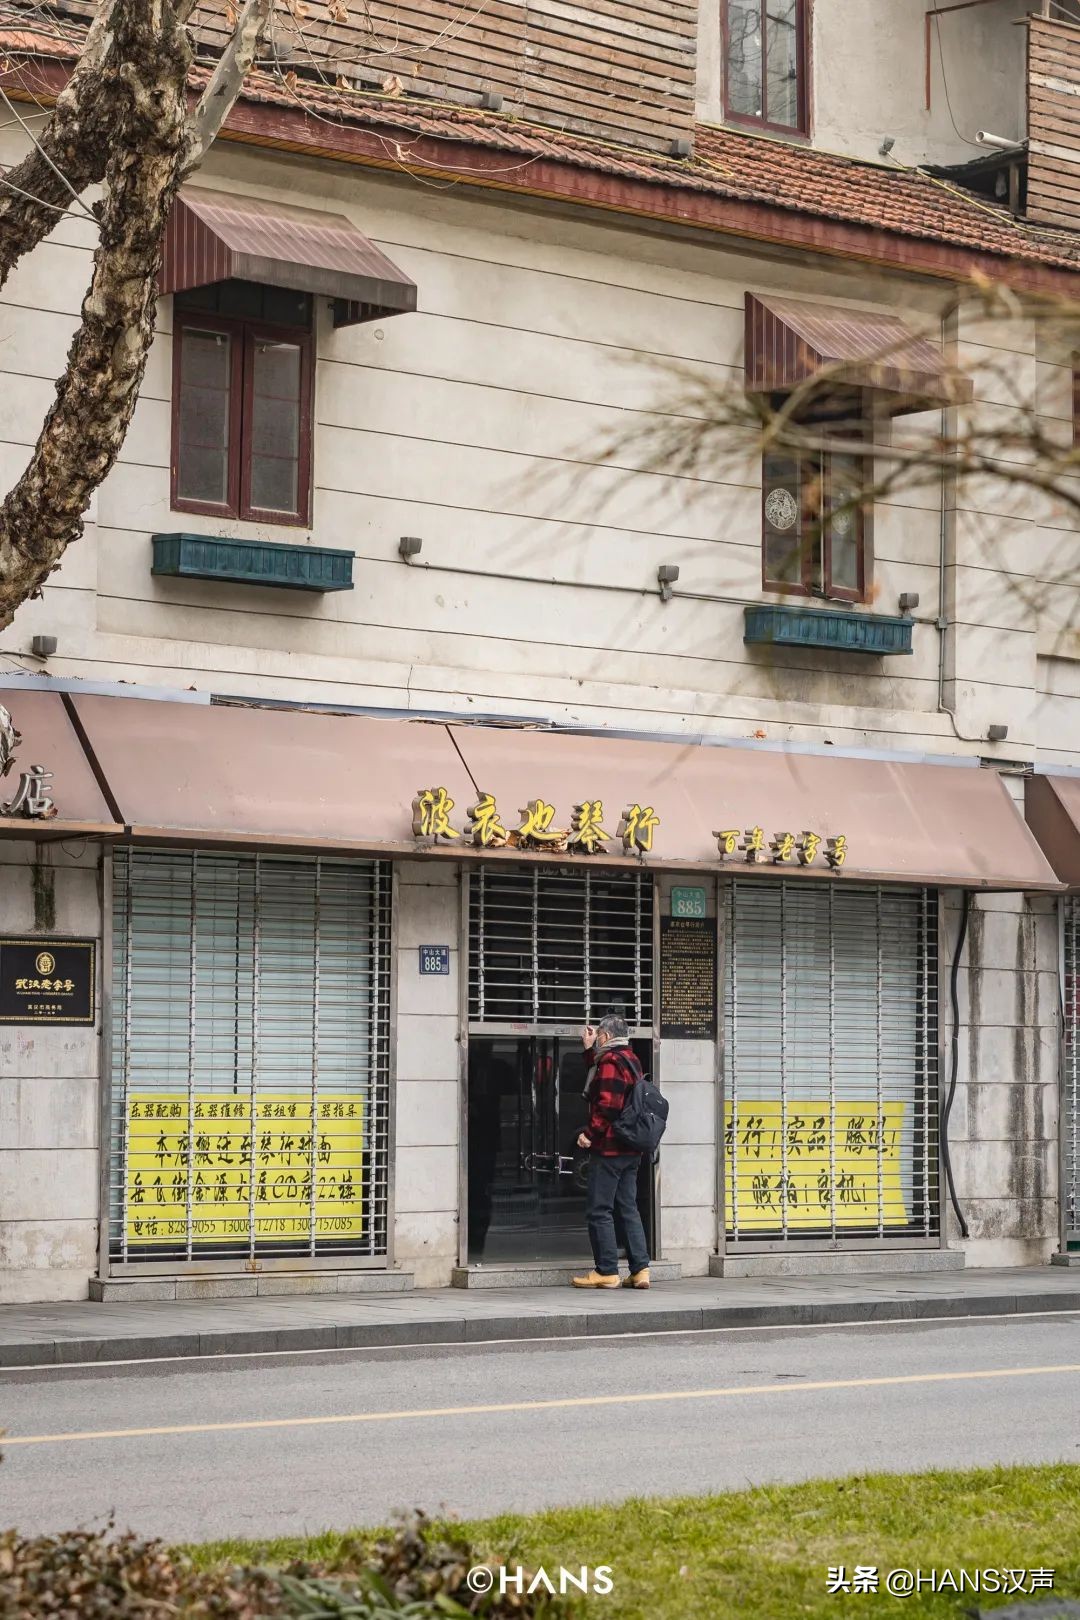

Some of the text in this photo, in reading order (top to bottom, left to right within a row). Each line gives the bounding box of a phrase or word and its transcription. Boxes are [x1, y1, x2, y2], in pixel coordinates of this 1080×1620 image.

[11, 765, 54, 815] 店
[712, 826, 847, 866] 百年老字号
[677, 899, 702, 915] 885
[425, 956, 441, 971] 885
[15, 979, 75, 991] 武汉老字号
